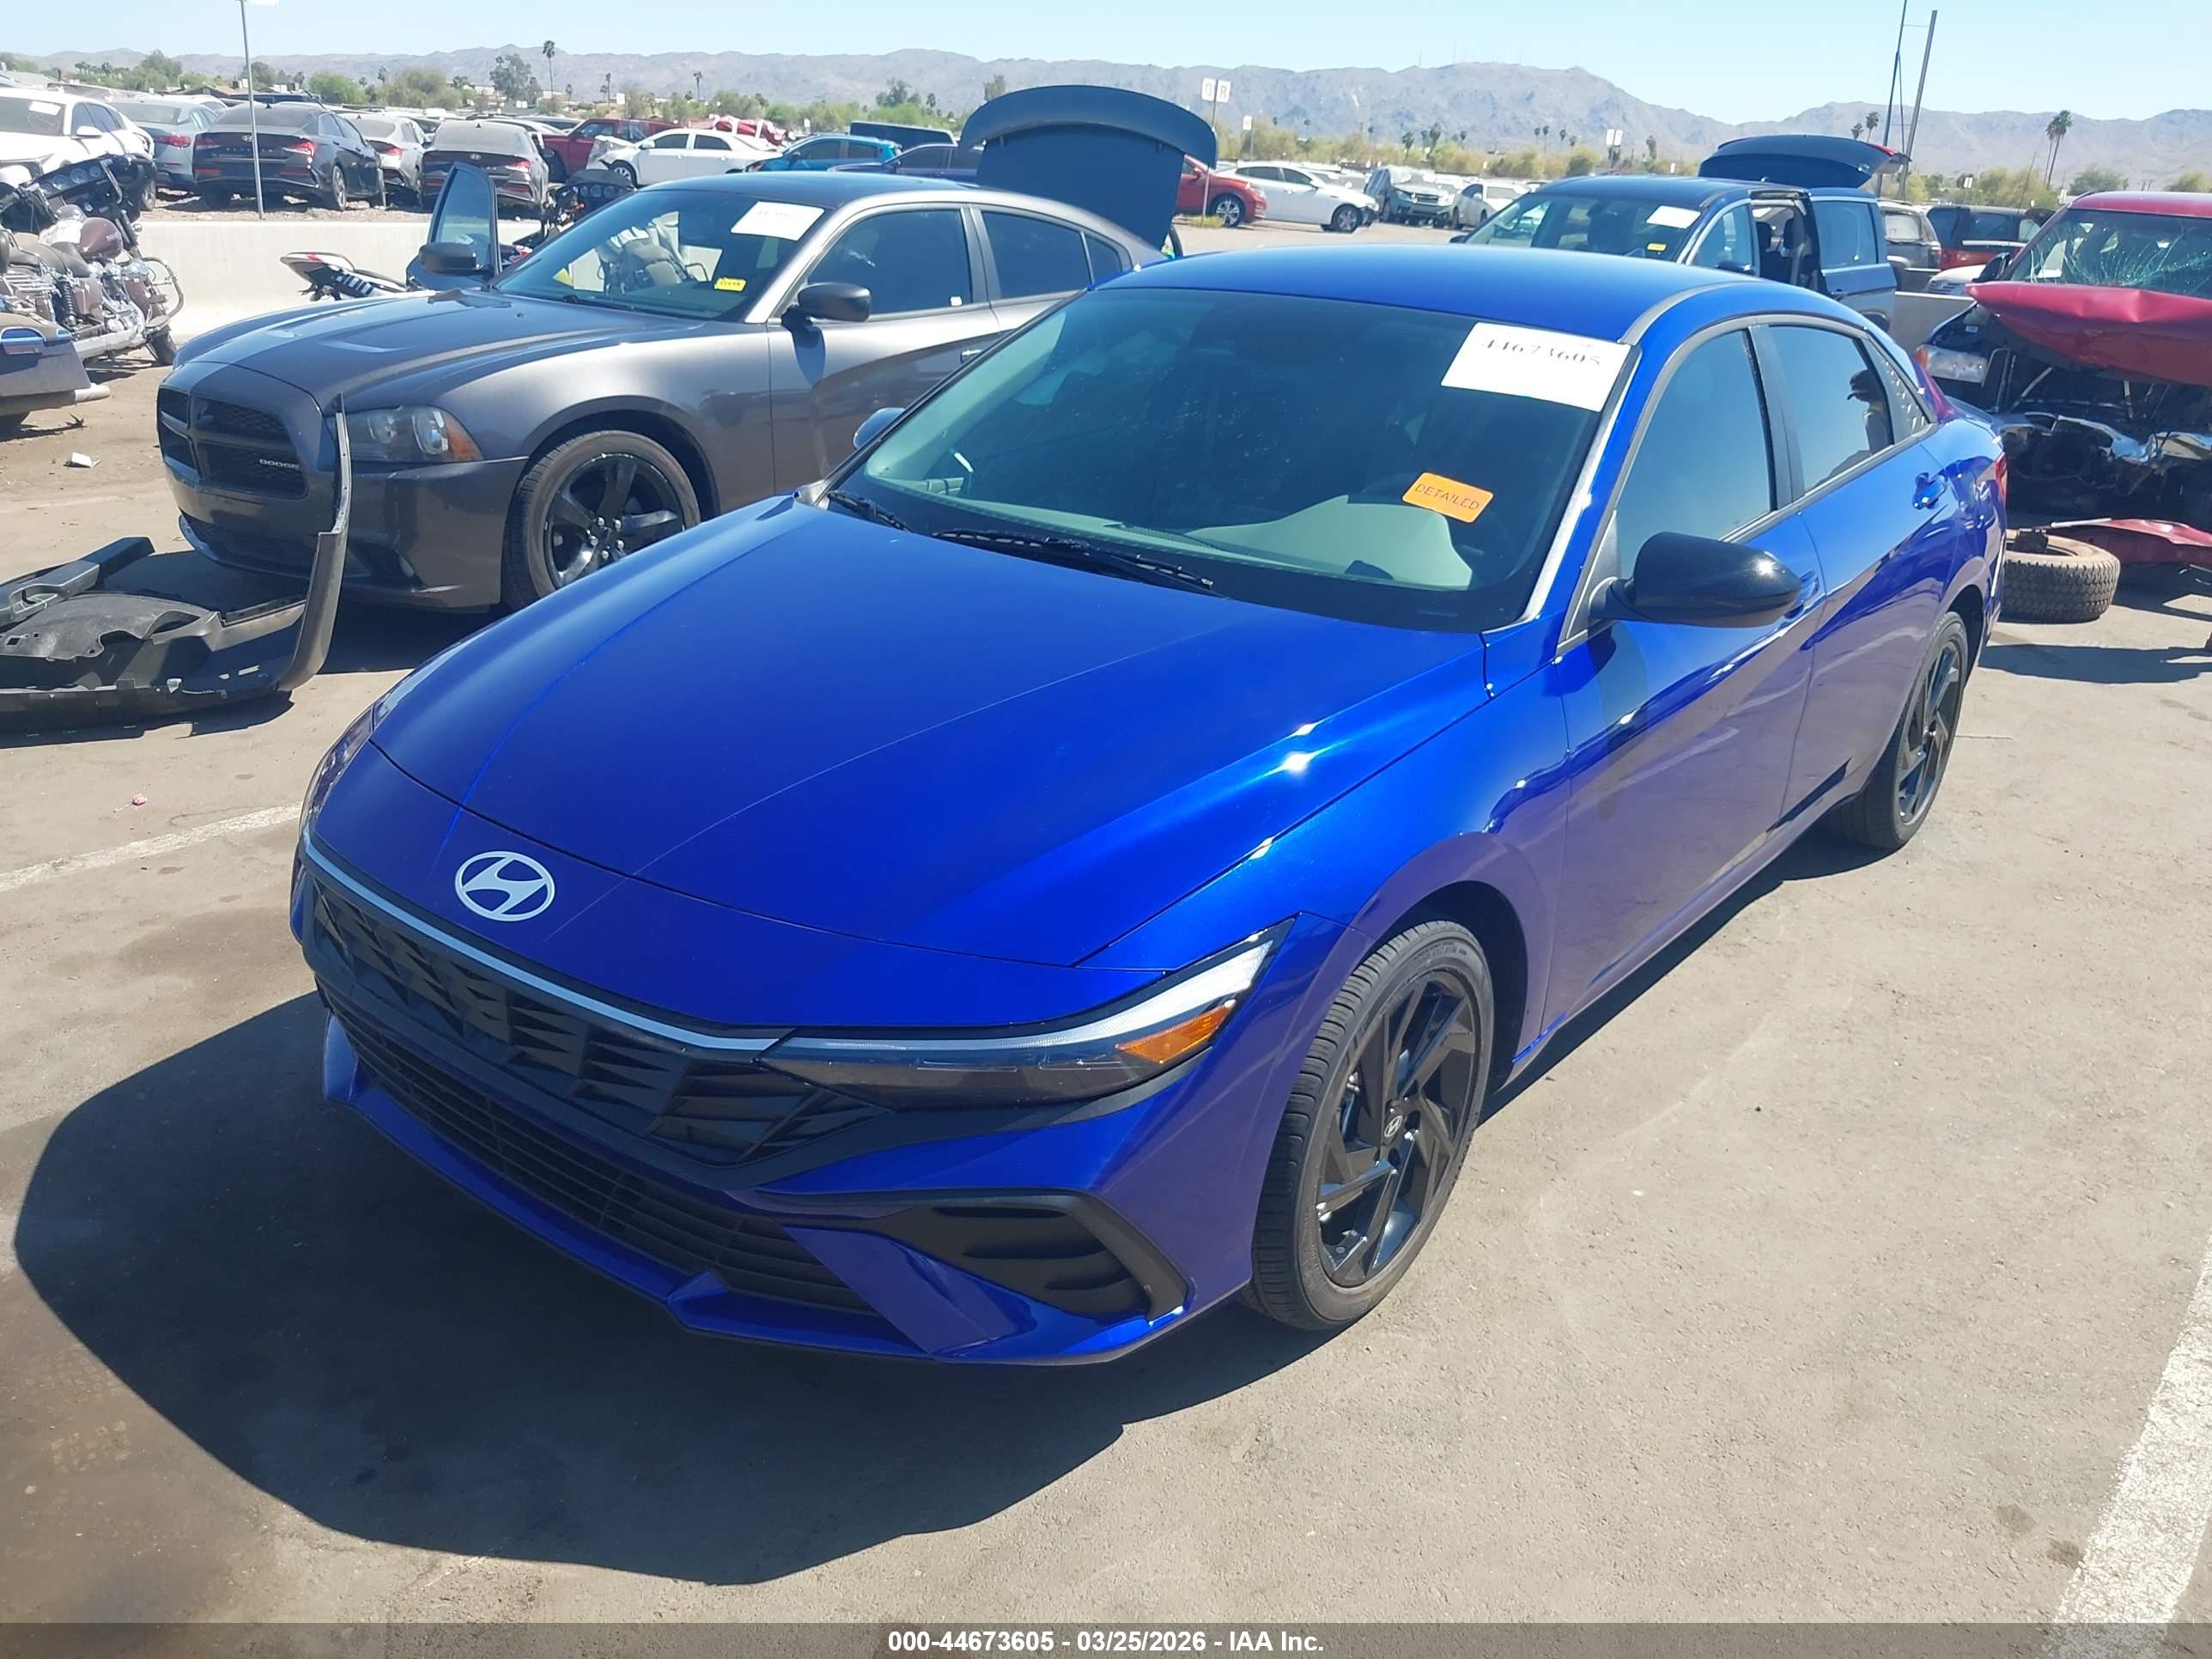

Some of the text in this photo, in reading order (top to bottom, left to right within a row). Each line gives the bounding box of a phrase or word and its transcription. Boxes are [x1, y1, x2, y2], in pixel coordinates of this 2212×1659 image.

[1220, 85, 1228, 100] R
[259, 459, 300, 470] DODGE
[1414, 483, 1480, 510] DETAILED
